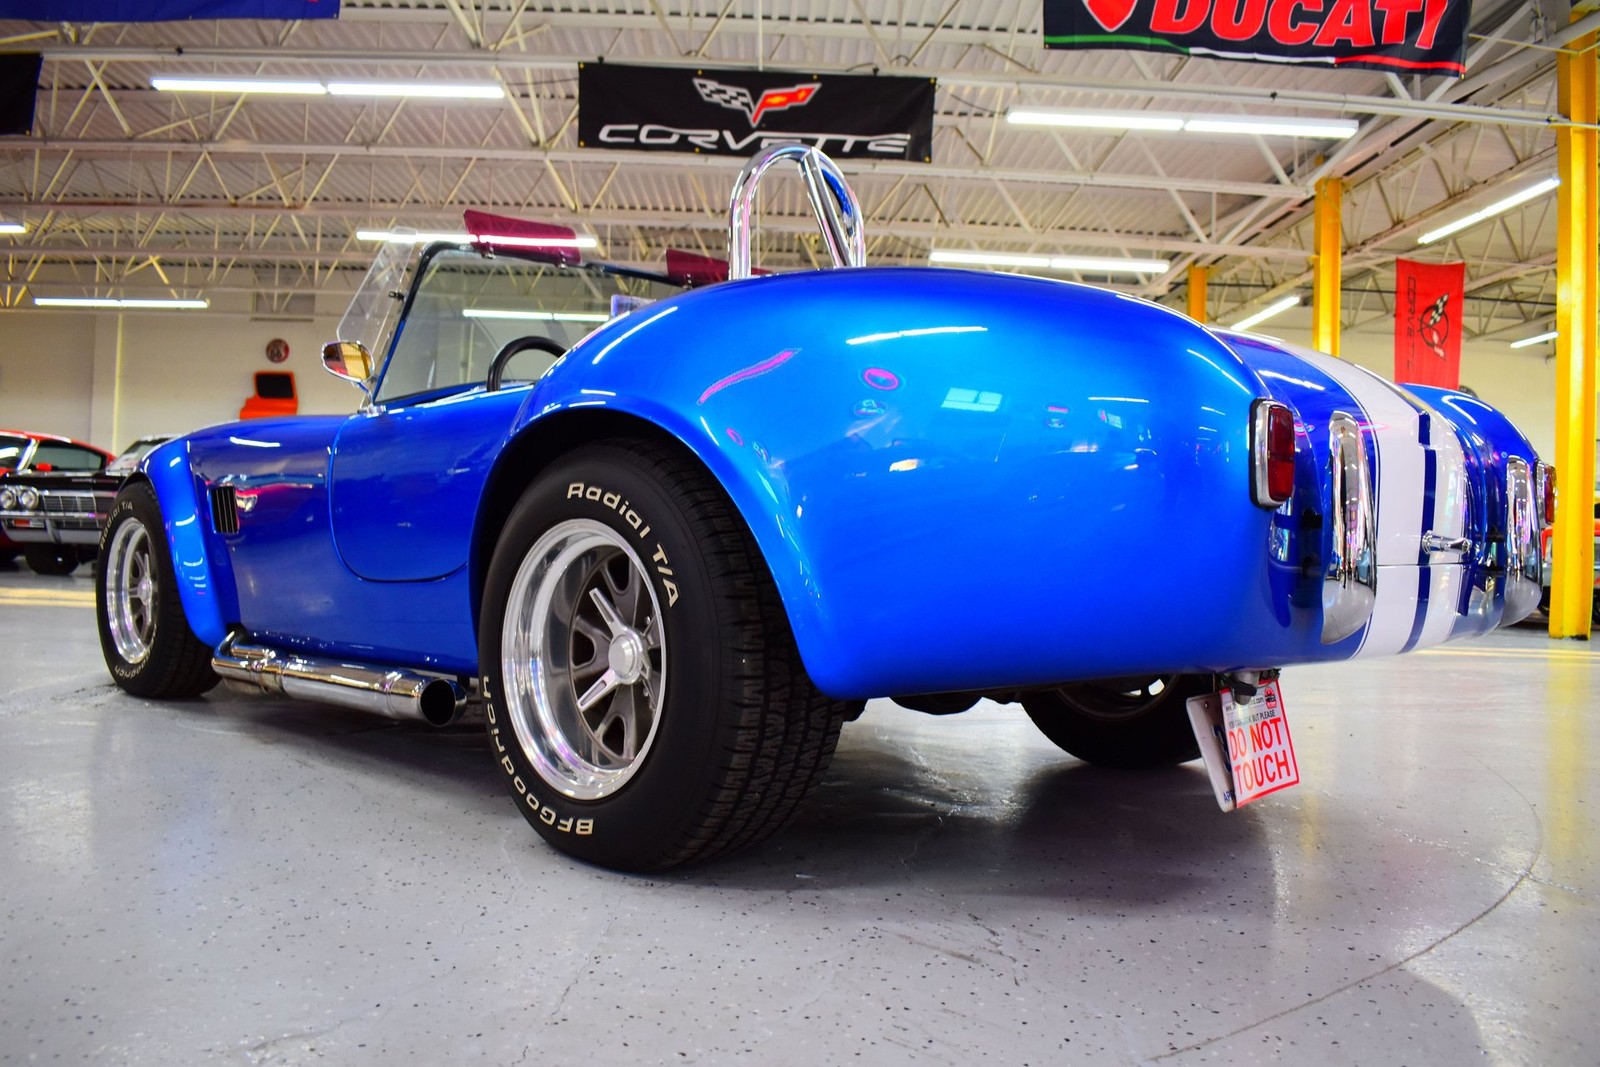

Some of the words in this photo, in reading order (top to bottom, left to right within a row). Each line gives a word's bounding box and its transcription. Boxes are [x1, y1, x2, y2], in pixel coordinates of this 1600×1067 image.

[1149, 0, 1450, 50] DUCATI
[598, 124, 912, 154] CORVETTE
[100, 505, 120, 551] Radial
[121, 501, 134, 511] T/A
[567, 482, 652, 539] Radial
[652, 543, 680, 608] T/A
[1259, 710, 1276, 720] PLEASE
[482, 675, 594, 836] BFGoodrich
[1228, 730, 1246, 761] DO
[1249, 717, 1281, 753] NOT
[1233, 749, 1291, 795] TOUCH
